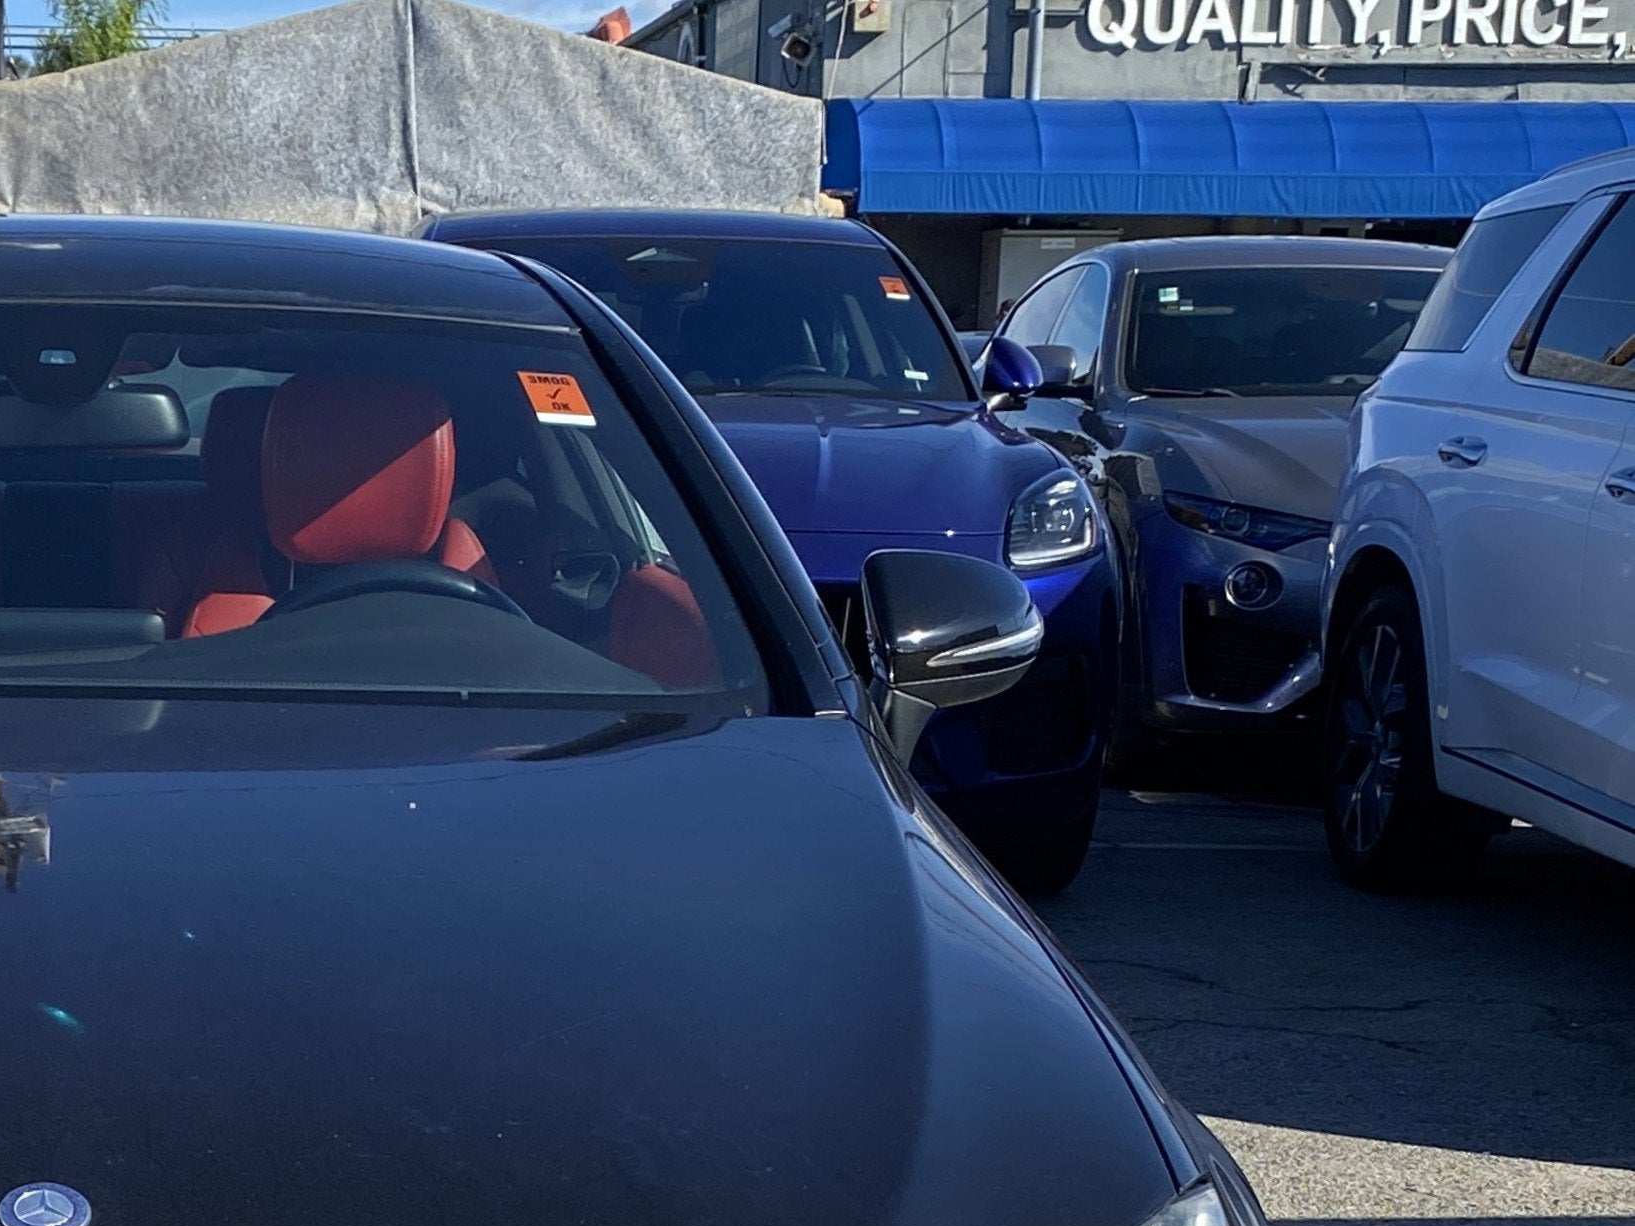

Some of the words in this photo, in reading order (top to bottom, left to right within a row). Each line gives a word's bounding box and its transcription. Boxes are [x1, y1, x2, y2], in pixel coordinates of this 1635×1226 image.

[1088, 0, 1392, 55] QUALITY,
[1409, 0, 1627, 57] PRICE,
[527, 375, 571, 386] SMOG
